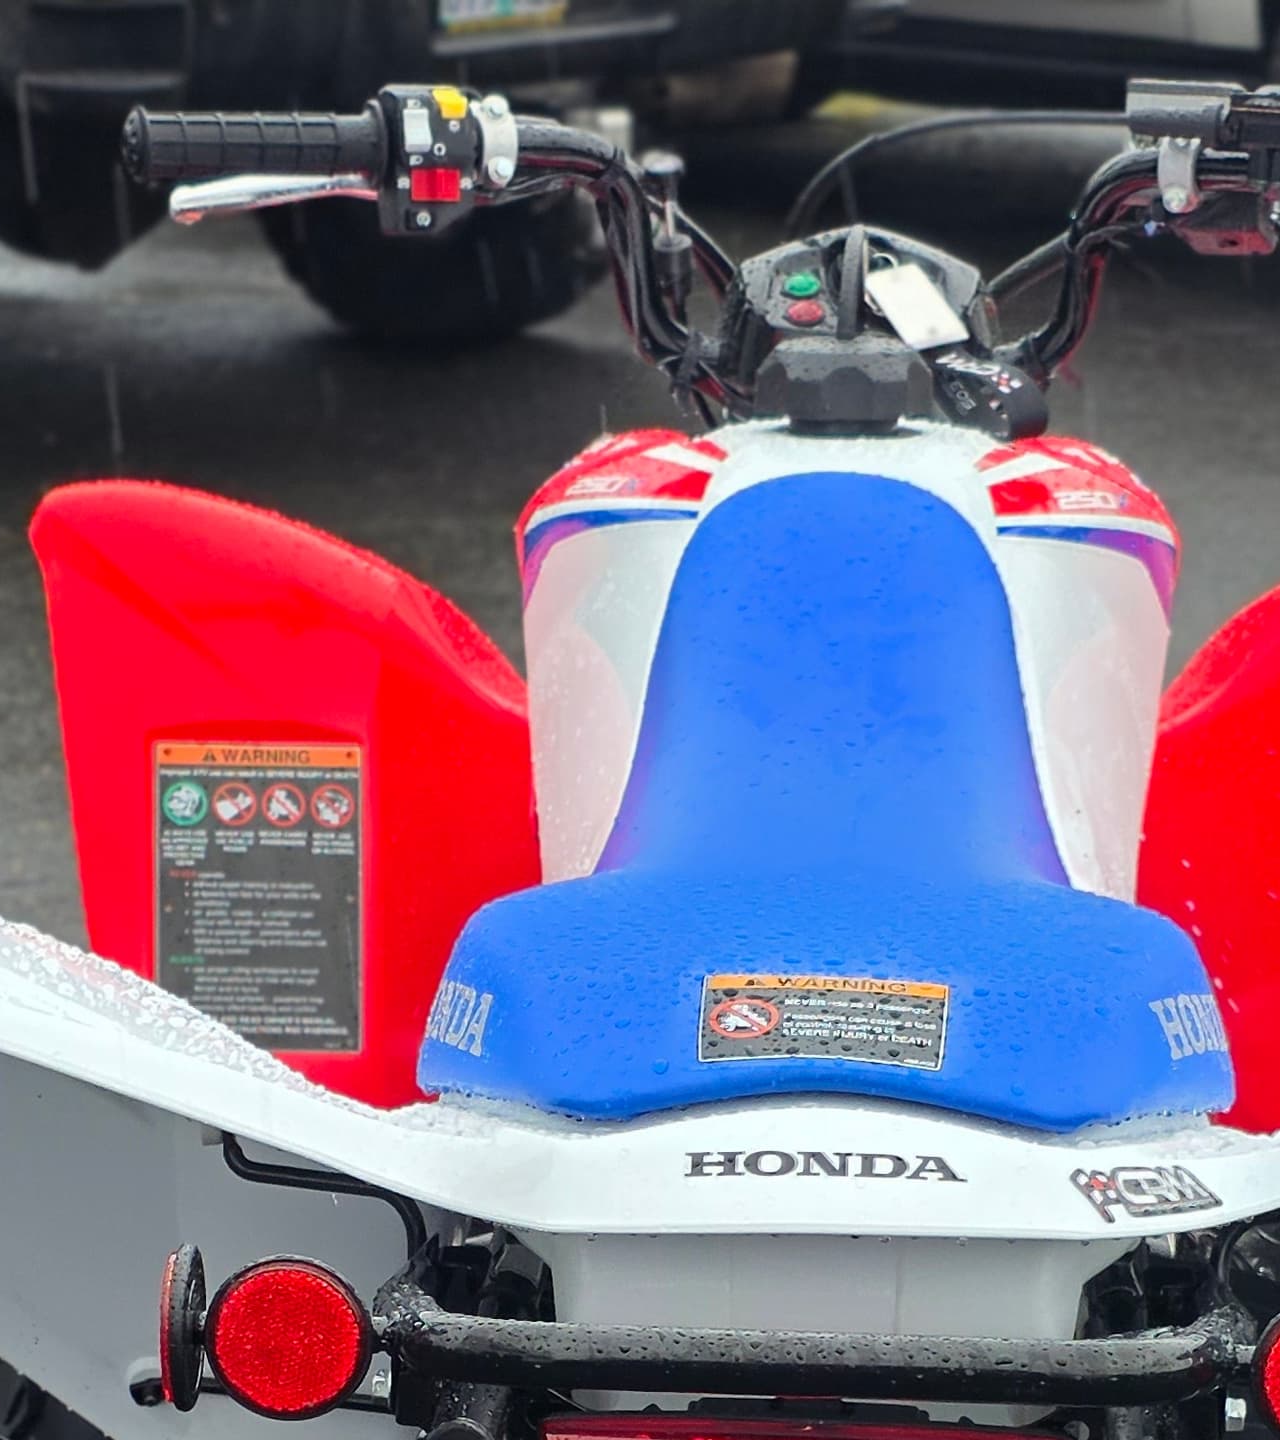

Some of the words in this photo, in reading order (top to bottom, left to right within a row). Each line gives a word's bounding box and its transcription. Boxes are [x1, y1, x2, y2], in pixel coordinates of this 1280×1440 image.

[221, 749, 311, 765] WARNING
[777, 977, 907, 993] WARNING
[683, 1149, 968, 1183] HONDA
